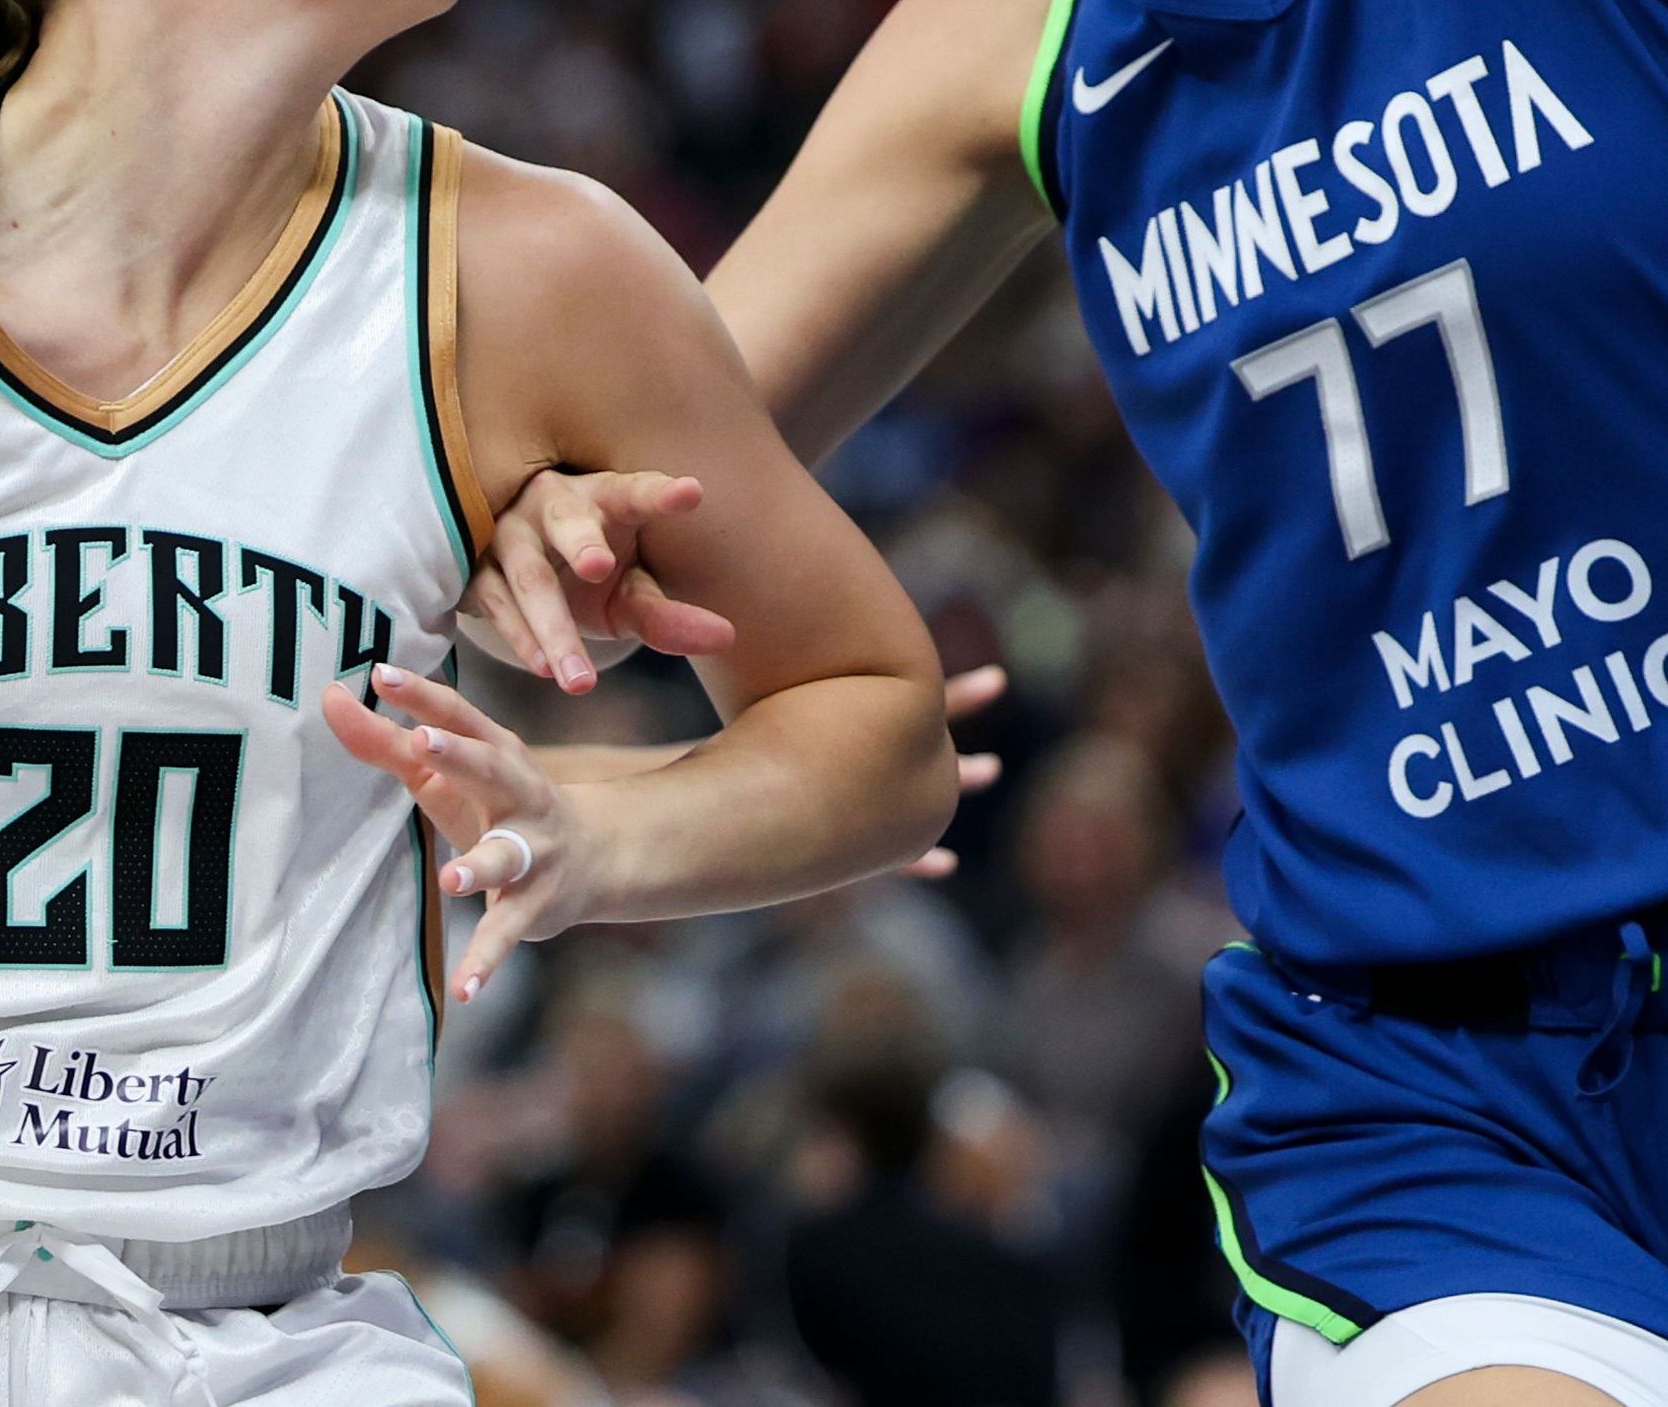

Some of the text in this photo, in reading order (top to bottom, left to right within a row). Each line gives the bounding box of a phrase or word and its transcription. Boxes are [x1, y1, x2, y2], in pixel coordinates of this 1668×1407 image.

[1099, 40, 1595, 357] MINNESOTA
[1230, 257, 1510, 560] 77
[1372, 538, 1652, 710] MAYO
[11, 1102, 202, 1160] Mutual
[23, 1045, 217, 1110] Liberty
